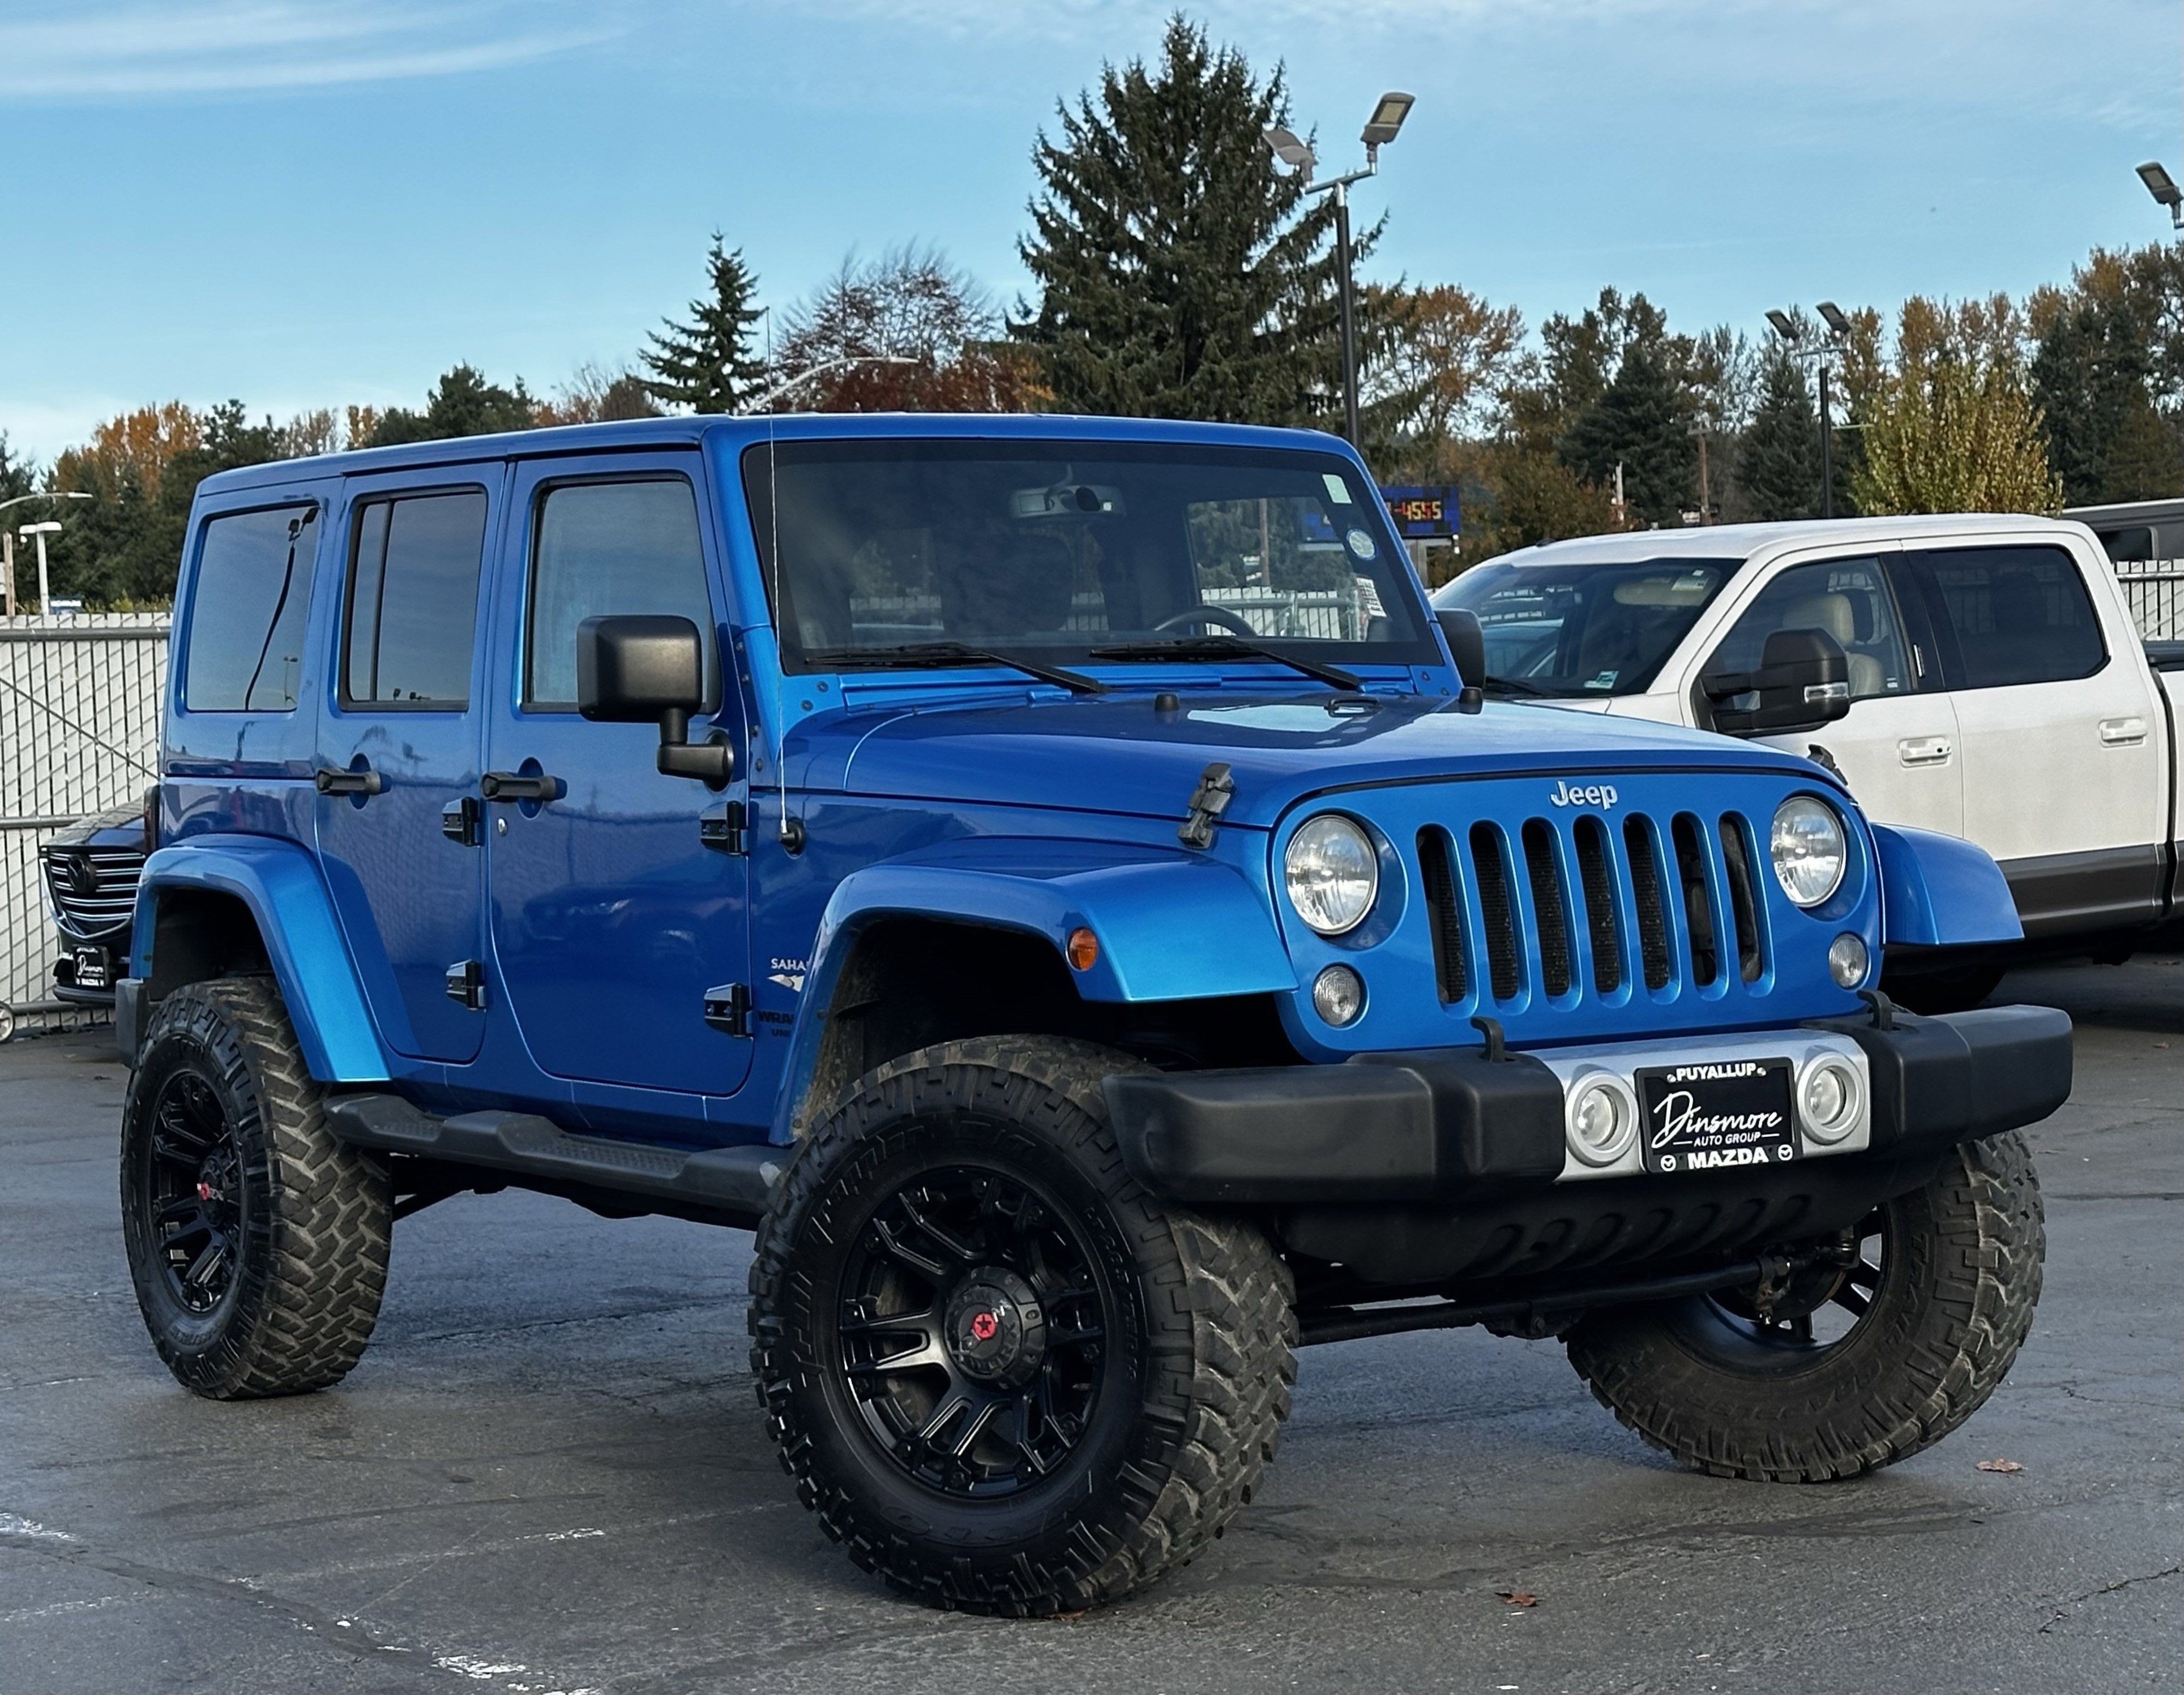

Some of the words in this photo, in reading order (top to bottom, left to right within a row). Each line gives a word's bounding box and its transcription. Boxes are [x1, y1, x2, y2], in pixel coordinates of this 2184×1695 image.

[1550, 780, 1618, 810] Jeep
[771, 957, 807, 971] SAHA
[1676, 1062, 1756, 1081] PUYALLUP
[1651, 1090, 1782, 1149] Dinsmore
[1693, 1134, 1723, 1147] AUTO
[1725, 1132, 1761, 1145] GROUP
[1687, 1147, 1770, 1170] MAZDA
